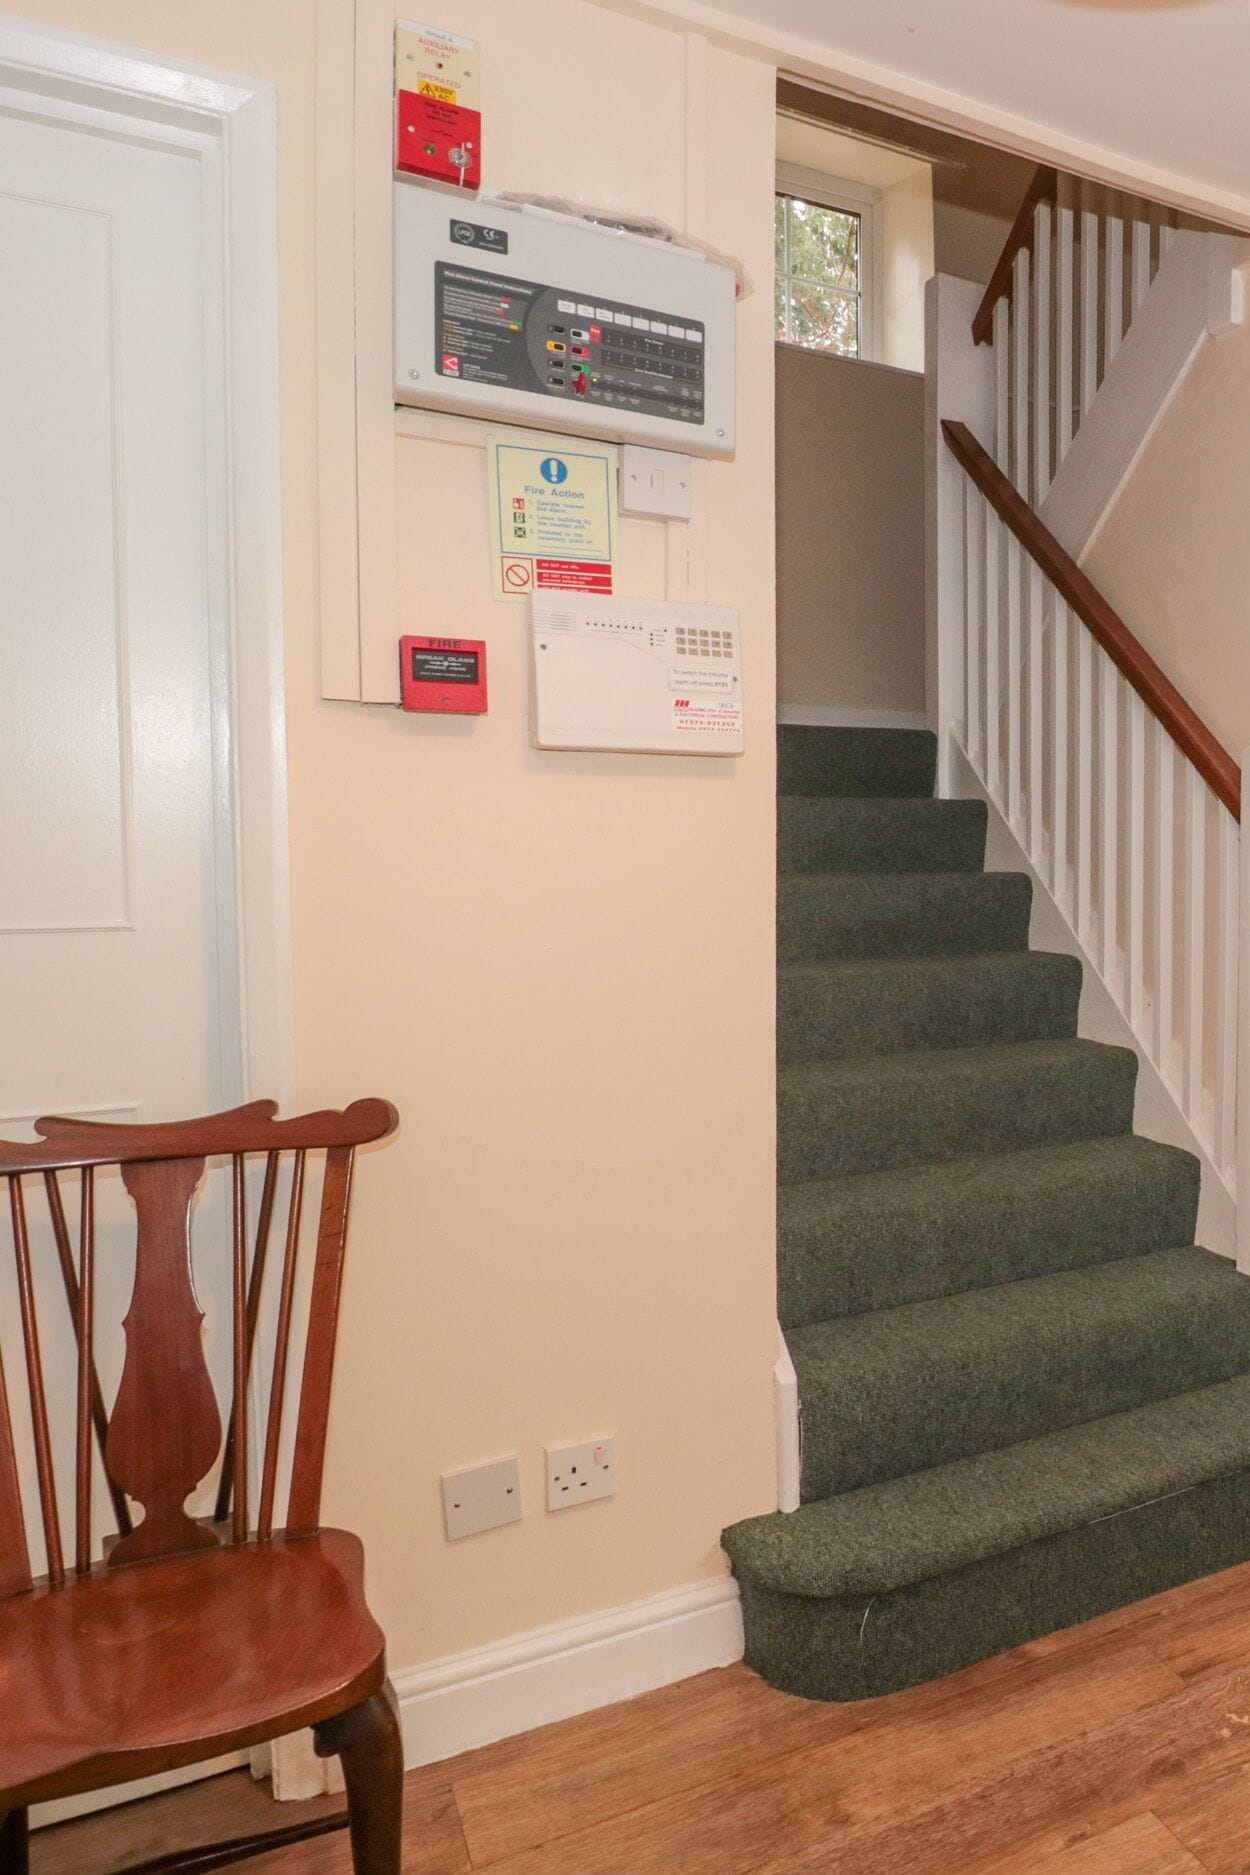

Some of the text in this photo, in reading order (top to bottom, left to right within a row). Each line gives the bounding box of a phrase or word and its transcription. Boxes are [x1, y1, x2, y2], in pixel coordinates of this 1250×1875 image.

[416, 37, 460, 54] AUXILIARY
[424, 47, 450, 59] RELAY
[416, 71, 461, 89] OPERATED
[524, 485, 585, 499] Fire Action
[429, 640, 462, 649] FIRE
[447, 656, 475, 664] GLASS
